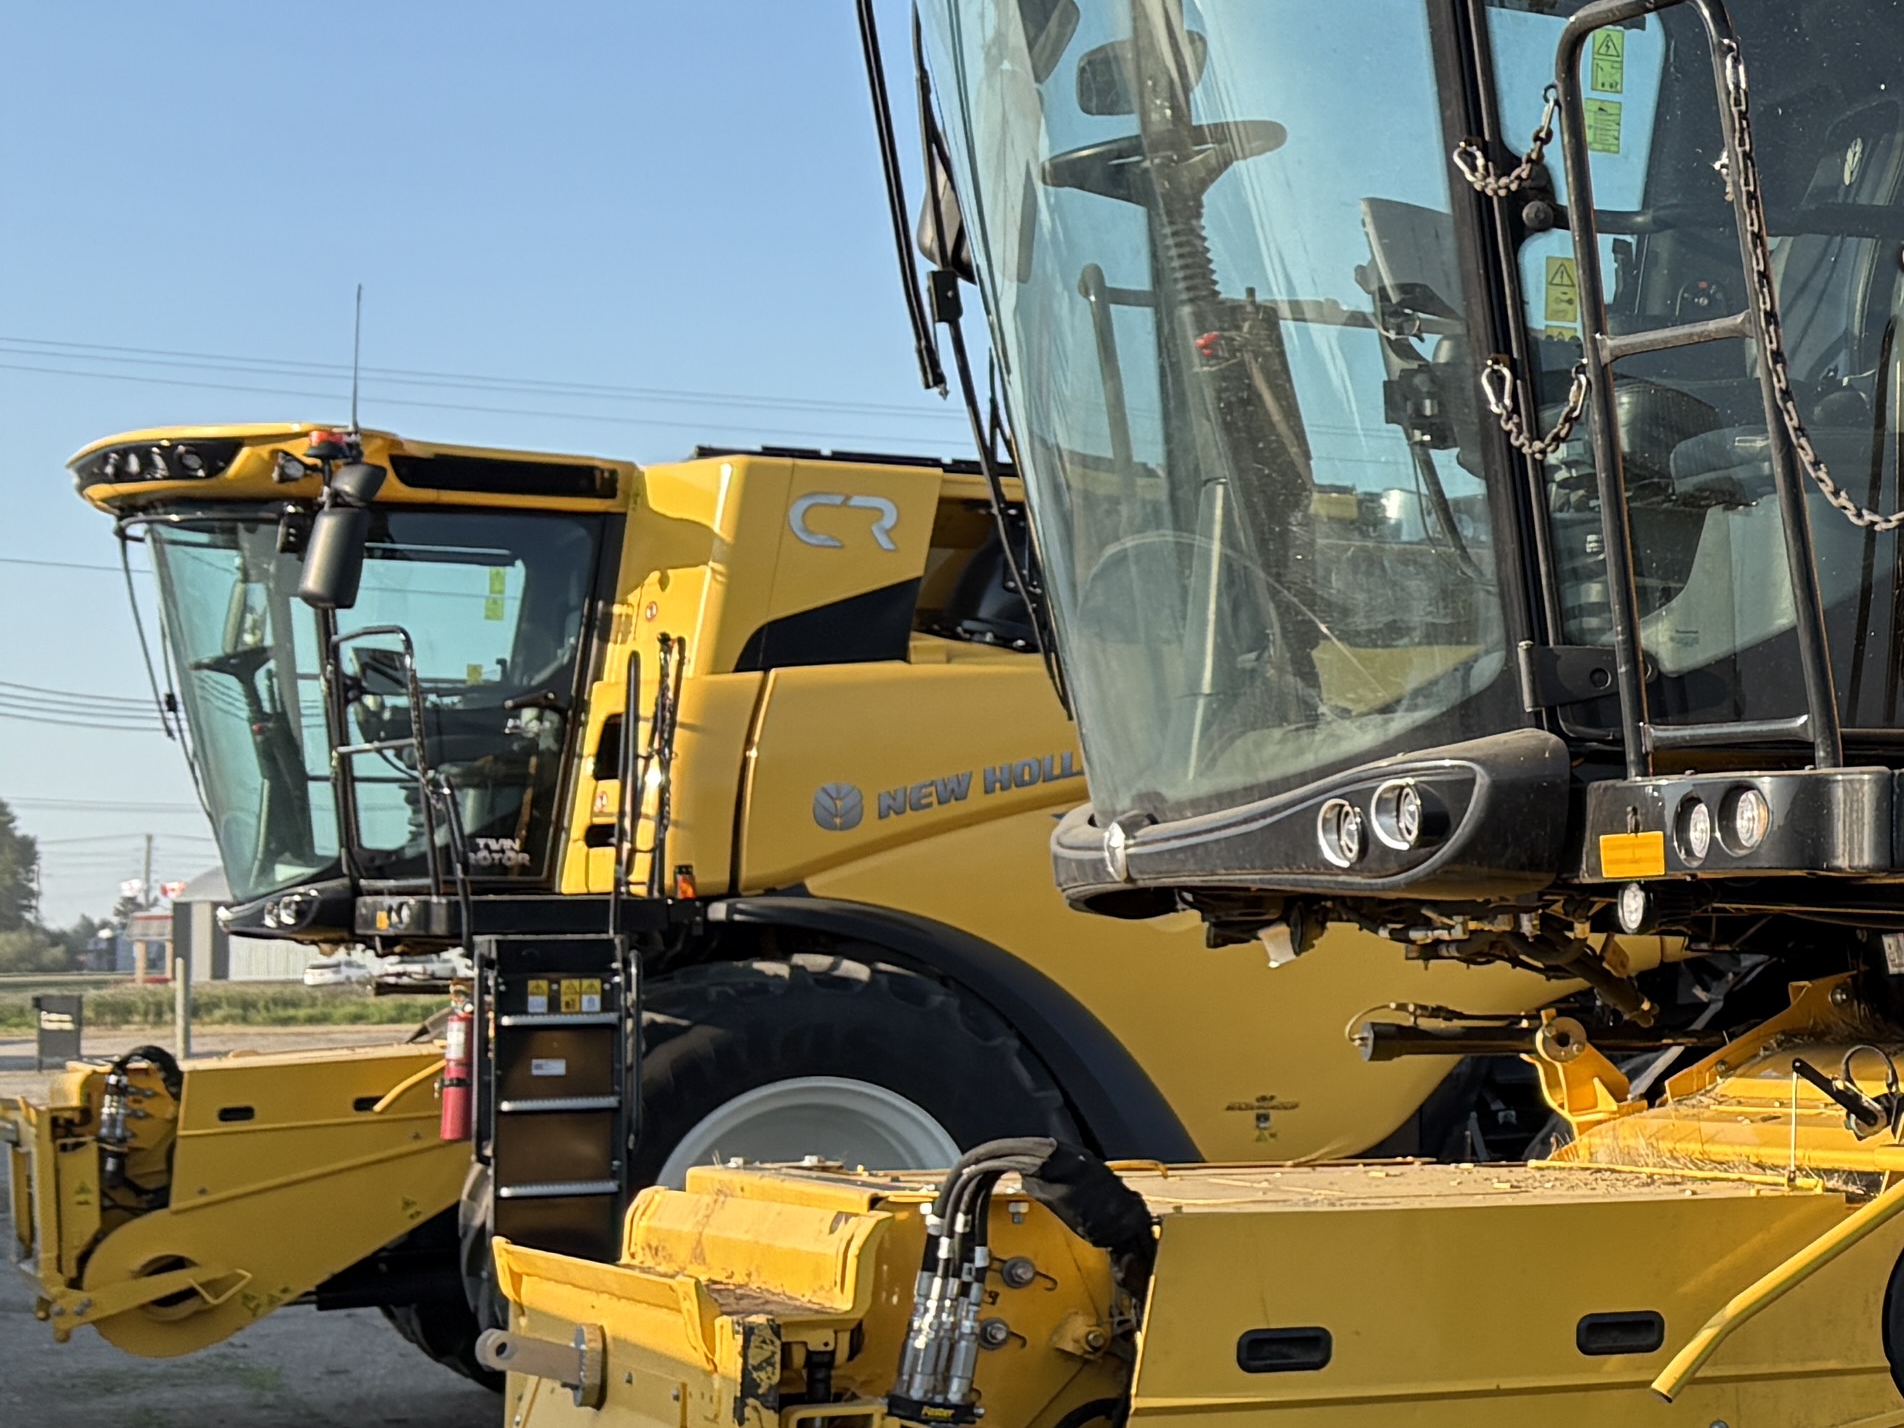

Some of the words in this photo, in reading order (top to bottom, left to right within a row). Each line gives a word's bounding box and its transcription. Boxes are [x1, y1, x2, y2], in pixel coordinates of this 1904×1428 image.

[788, 492, 898, 552] CR
[877, 770, 974, 821] NEW
[983, 750, 1086, 795] HOLL
[475, 837, 521, 852] TWIN
